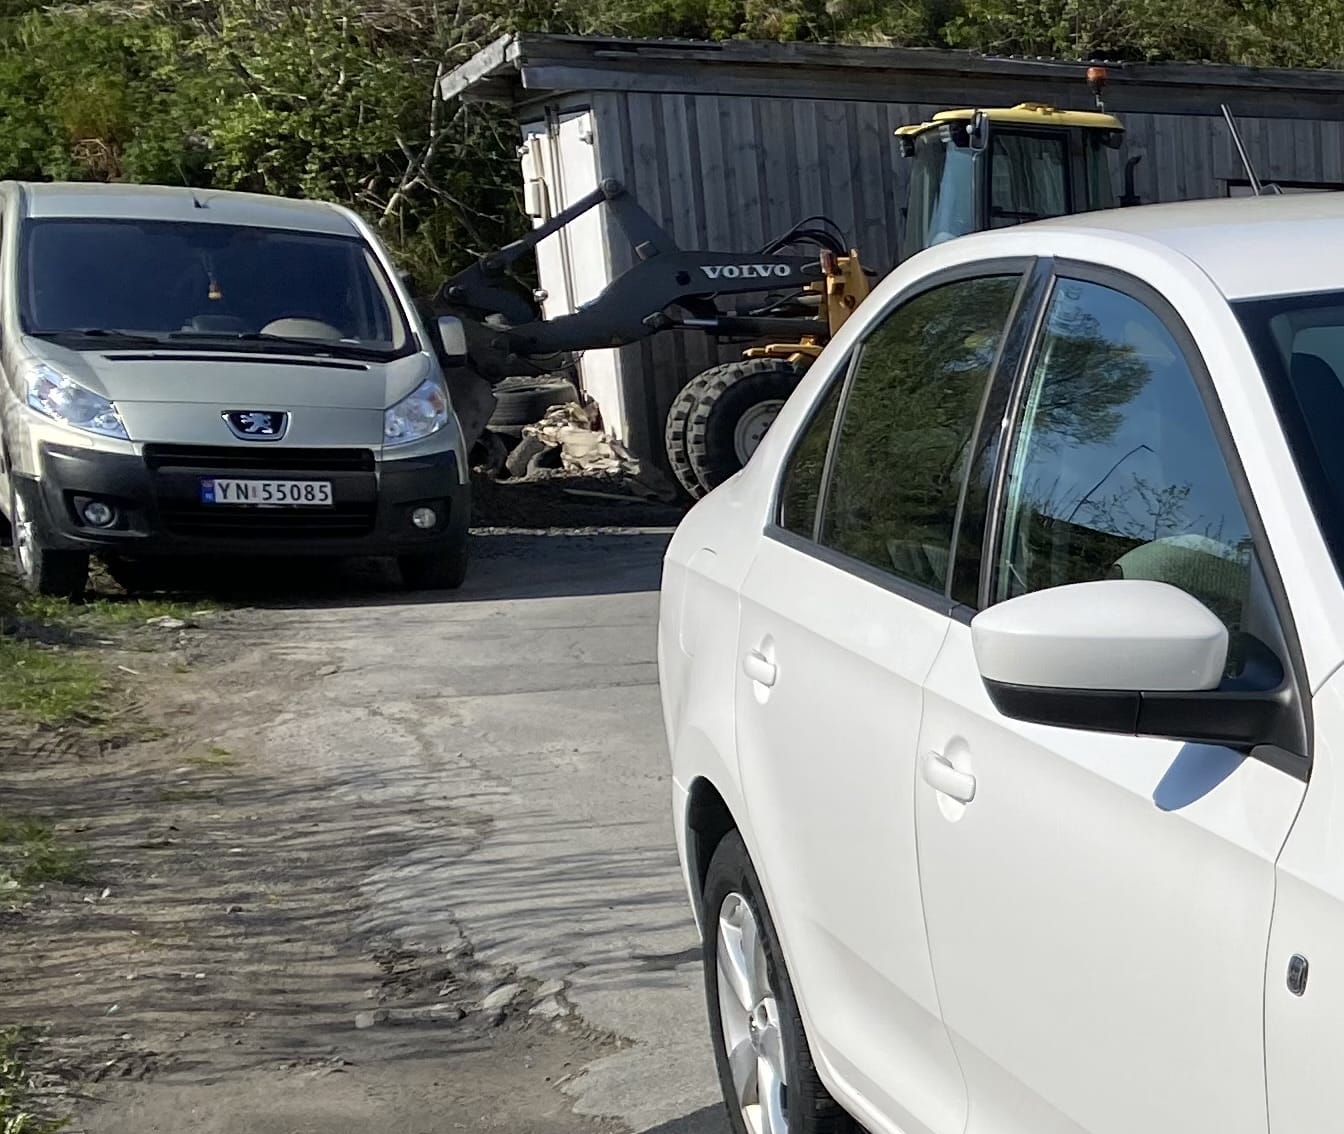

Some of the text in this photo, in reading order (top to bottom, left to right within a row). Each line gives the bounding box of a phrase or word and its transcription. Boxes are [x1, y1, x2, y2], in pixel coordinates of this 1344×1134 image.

[700, 264, 791, 278] VOLVO
[217, 482, 329, 502] YN 55085
